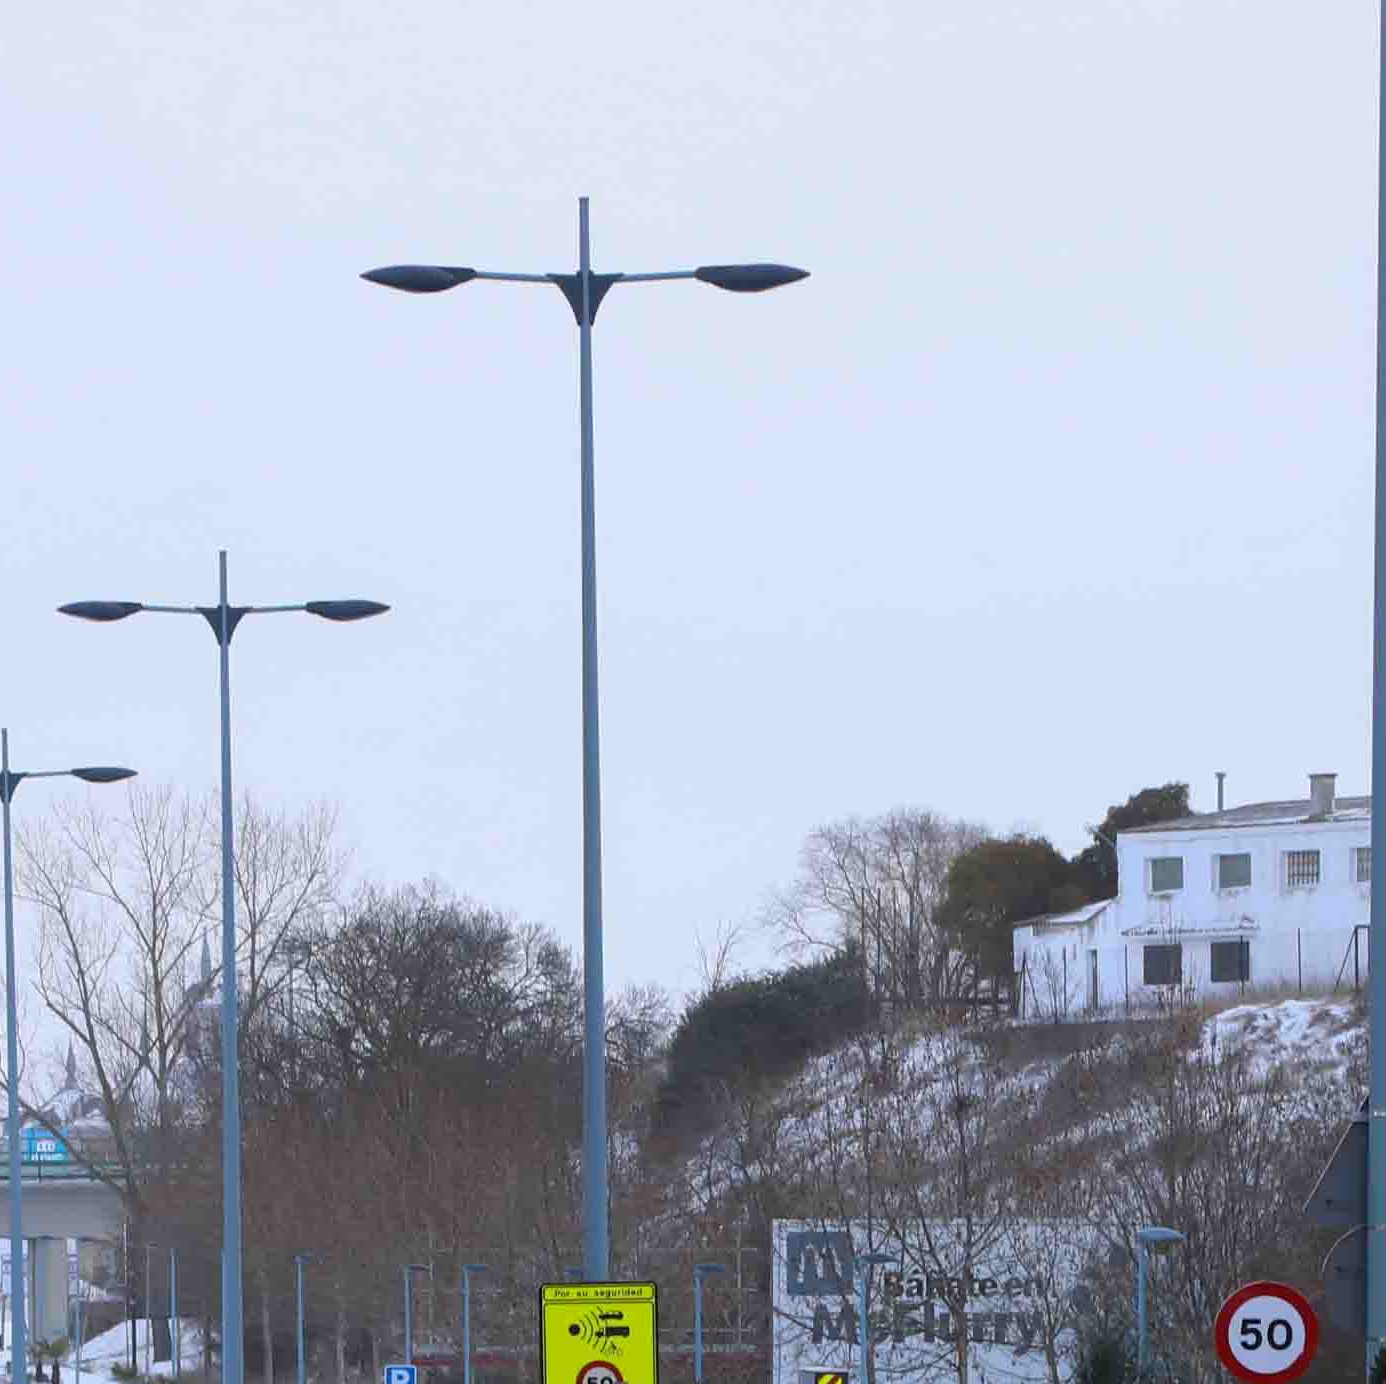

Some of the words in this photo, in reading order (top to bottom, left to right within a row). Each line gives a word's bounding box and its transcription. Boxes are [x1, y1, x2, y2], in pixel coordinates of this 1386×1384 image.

[554, 1289, 570, 1298] Por
[576, 1290, 588, 1298] su
[593, 1287, 643, 1299] seguridad
[1003, 1277, 1044, 1298] en
[1240, 1318, 1293, 1351] 50
